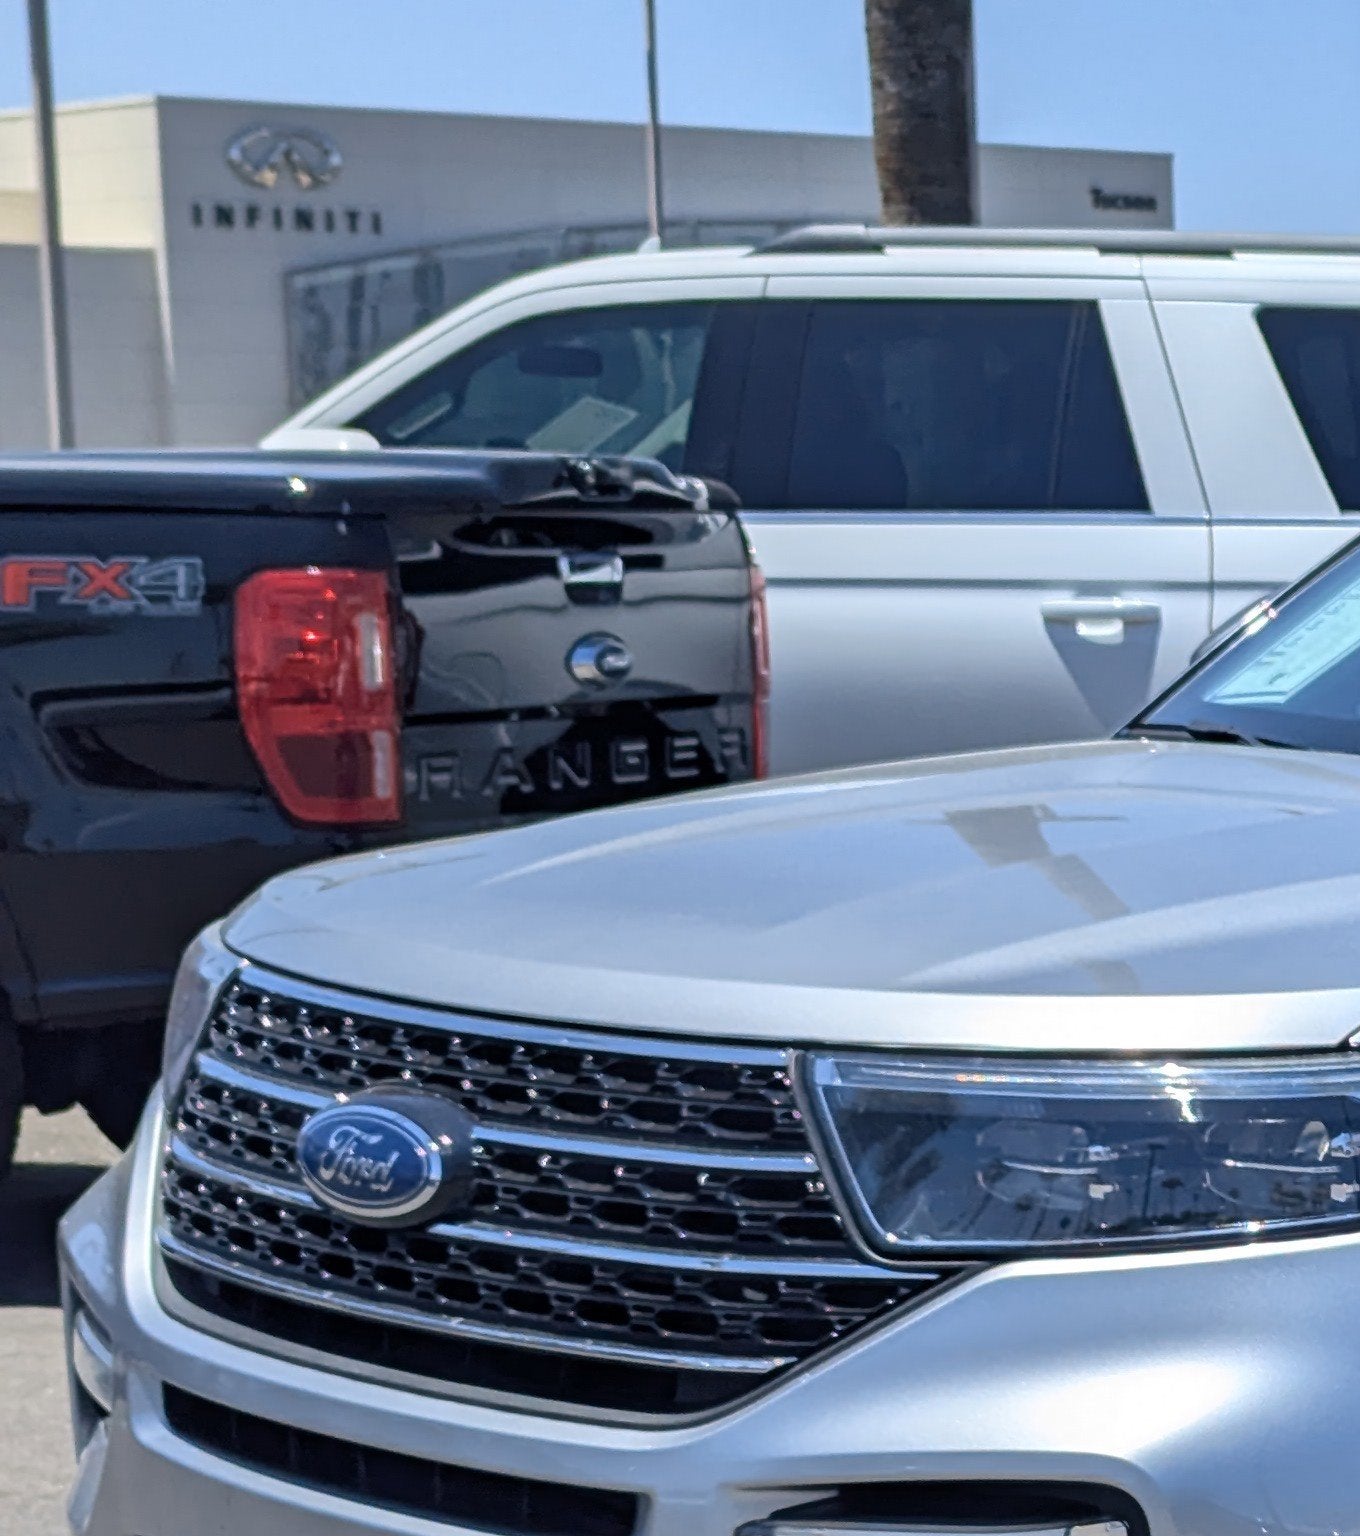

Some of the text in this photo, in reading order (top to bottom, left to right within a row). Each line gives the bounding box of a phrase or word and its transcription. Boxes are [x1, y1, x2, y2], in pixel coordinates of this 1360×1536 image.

[191, 203, 382, 235] INFINITI
[0, 556, 204, 612] FX4
[416, 727, 748, 801] RANGER
[319, 1126, 400, 1192] Ford
